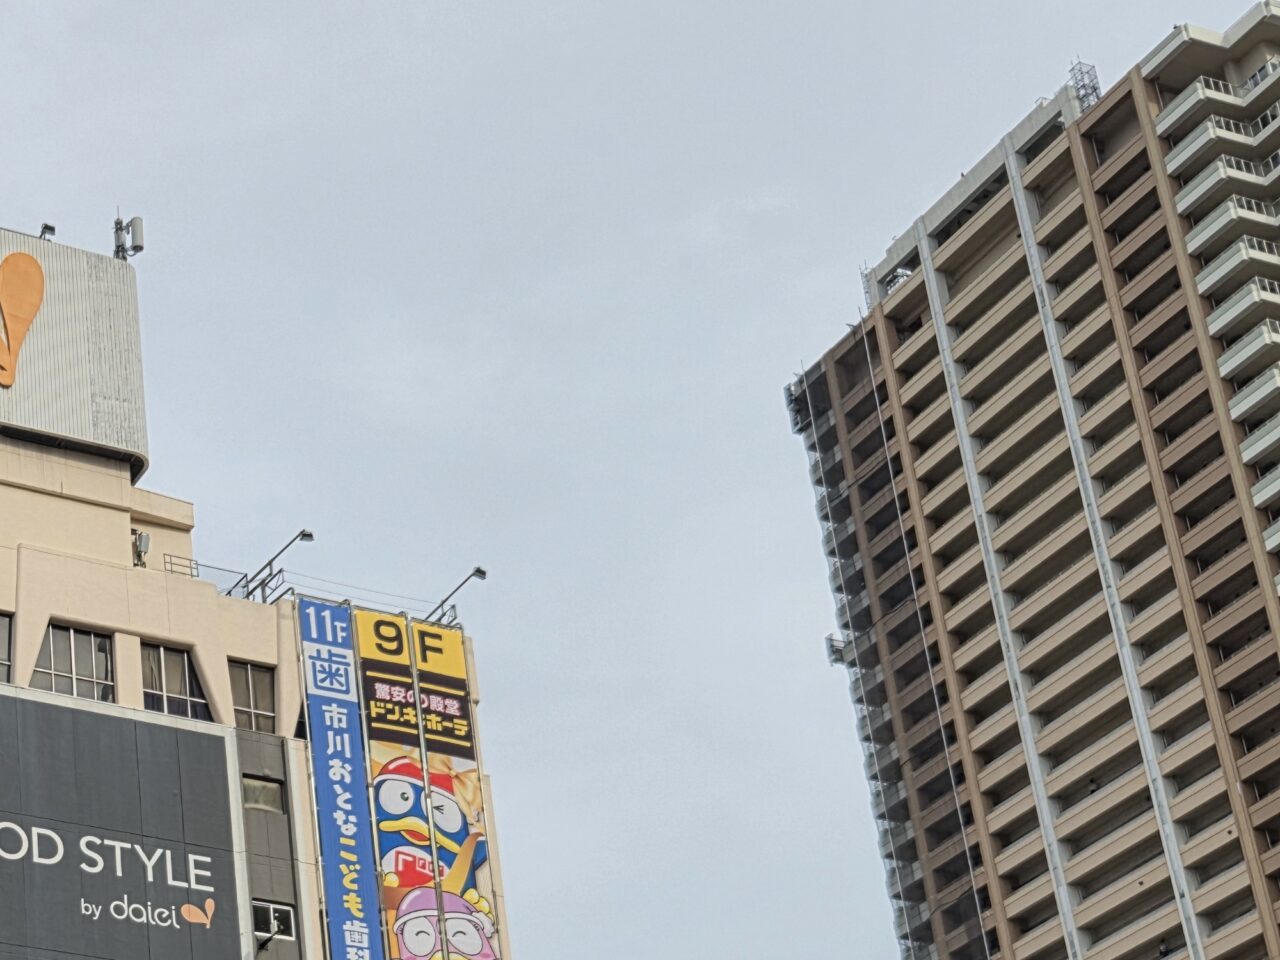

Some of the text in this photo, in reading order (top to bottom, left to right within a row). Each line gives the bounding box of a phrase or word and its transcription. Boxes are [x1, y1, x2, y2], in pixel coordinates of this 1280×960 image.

[305, 605, 347, 643] 11F
[308, 648, 351, 694] 歯
[79, 835, 215, 892] STYLE
[81, 894, 181, 930] by daiei
